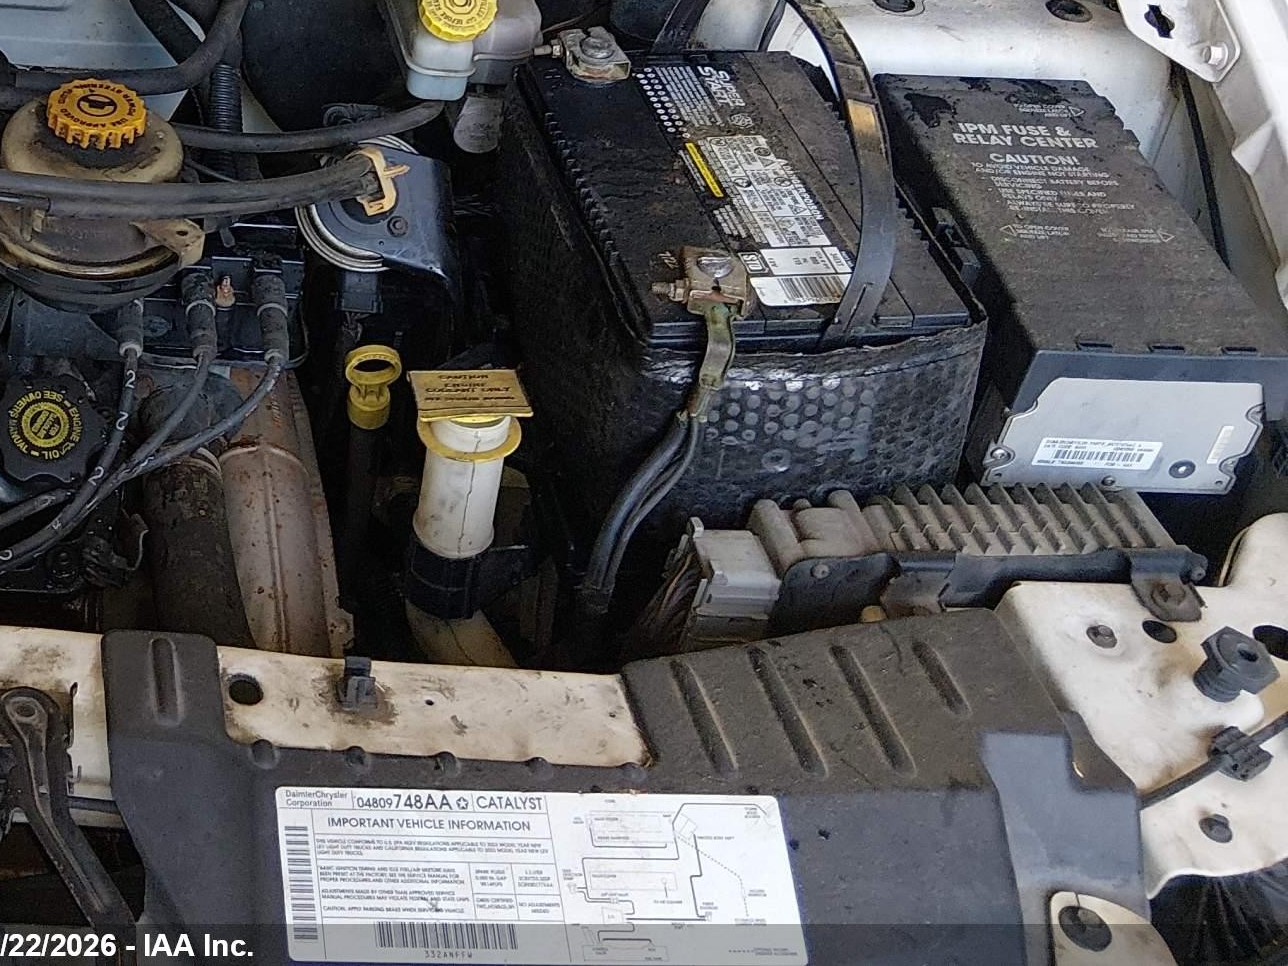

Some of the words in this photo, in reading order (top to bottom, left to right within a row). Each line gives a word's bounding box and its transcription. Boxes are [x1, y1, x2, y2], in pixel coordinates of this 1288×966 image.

[698, 66, 729, 106] START
[718, 70, 746, 107] SUPER
[958, 123, 998, 134] IPM
[1001, 124, 1051, 136] FUSE
[1055, 126, 1072, 137] &
[952, 133, 1012, 146] RELAY
[1019, 136, 1099, 148] CENTER
[989, 153, 1081, 166] CAUTION!
[125, 370, 136, 389] 2
[43, 390, 64, 402] SEE
[69, 406, 81, 442] ENGINE
[42, 449, 60, 460] OIL
[285, 790, 347, 800] DaimlerChrysler
[356, 793, 453, 810] 04809748AA
[476, 795, 542, 810] CATALYST
[286, 798, 332, 808] Corporation
[328, 817, 394, 829] IMPORTANT
[397, 818, 445, 830] VEHICLE
[448, 819, 531, 832] INFORMATION
